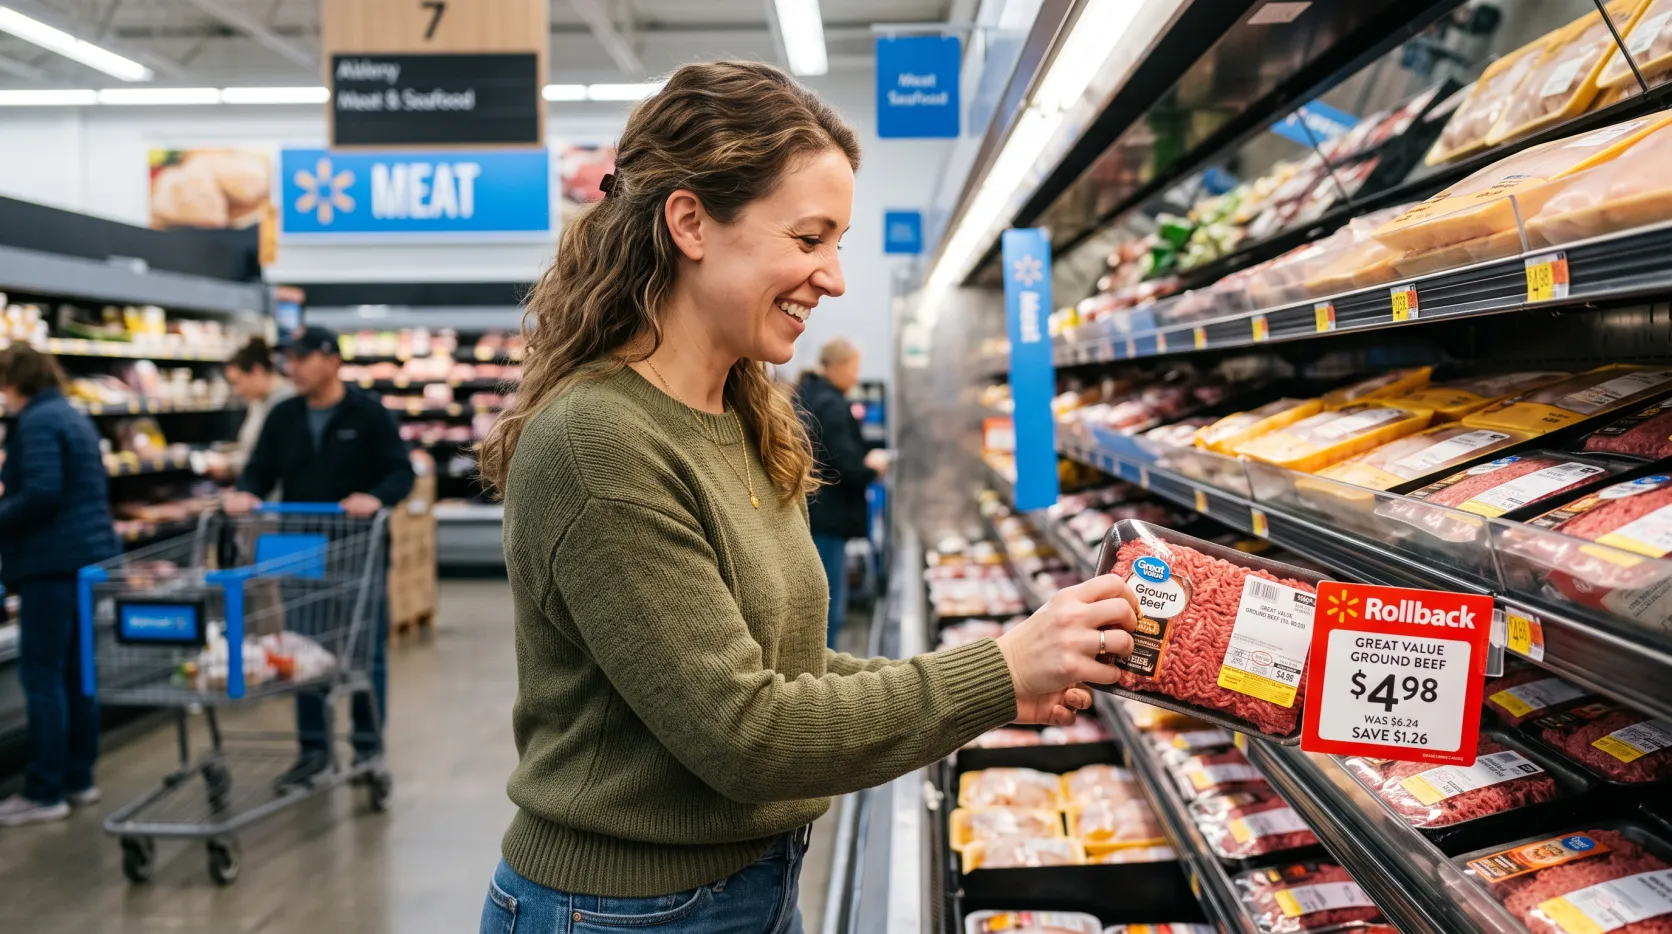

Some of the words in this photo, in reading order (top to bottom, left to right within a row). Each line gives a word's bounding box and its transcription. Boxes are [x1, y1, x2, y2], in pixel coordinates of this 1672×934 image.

[420, 1, 447, 41] 7
[371, 162, 481, 219] MEAT
[1138, 560, 1165, 574] Great
[1135, 583, 1177, 602] Ground
[1140, 596, 1166, 610] Beef
[1245, 607, 1267, 618] GROUND
[1267, 613, 1281, 622] BEEF
[1365, 598, 1477, 629] Rollback
[1355, 637, 1399, 651] GREAT
[1402, 641, 1445, 656] VALUE
[1350, 651, 1411, 667] GROUND
[1414, 657, 1447, 670] BEEF
[1364, 714, 1388, 725] WAS
[1391, 716, 1419, 729] $6.24
[1352, 727, 1390, 742] SAVE
[1394, 730, 1428, 745] $1.26
